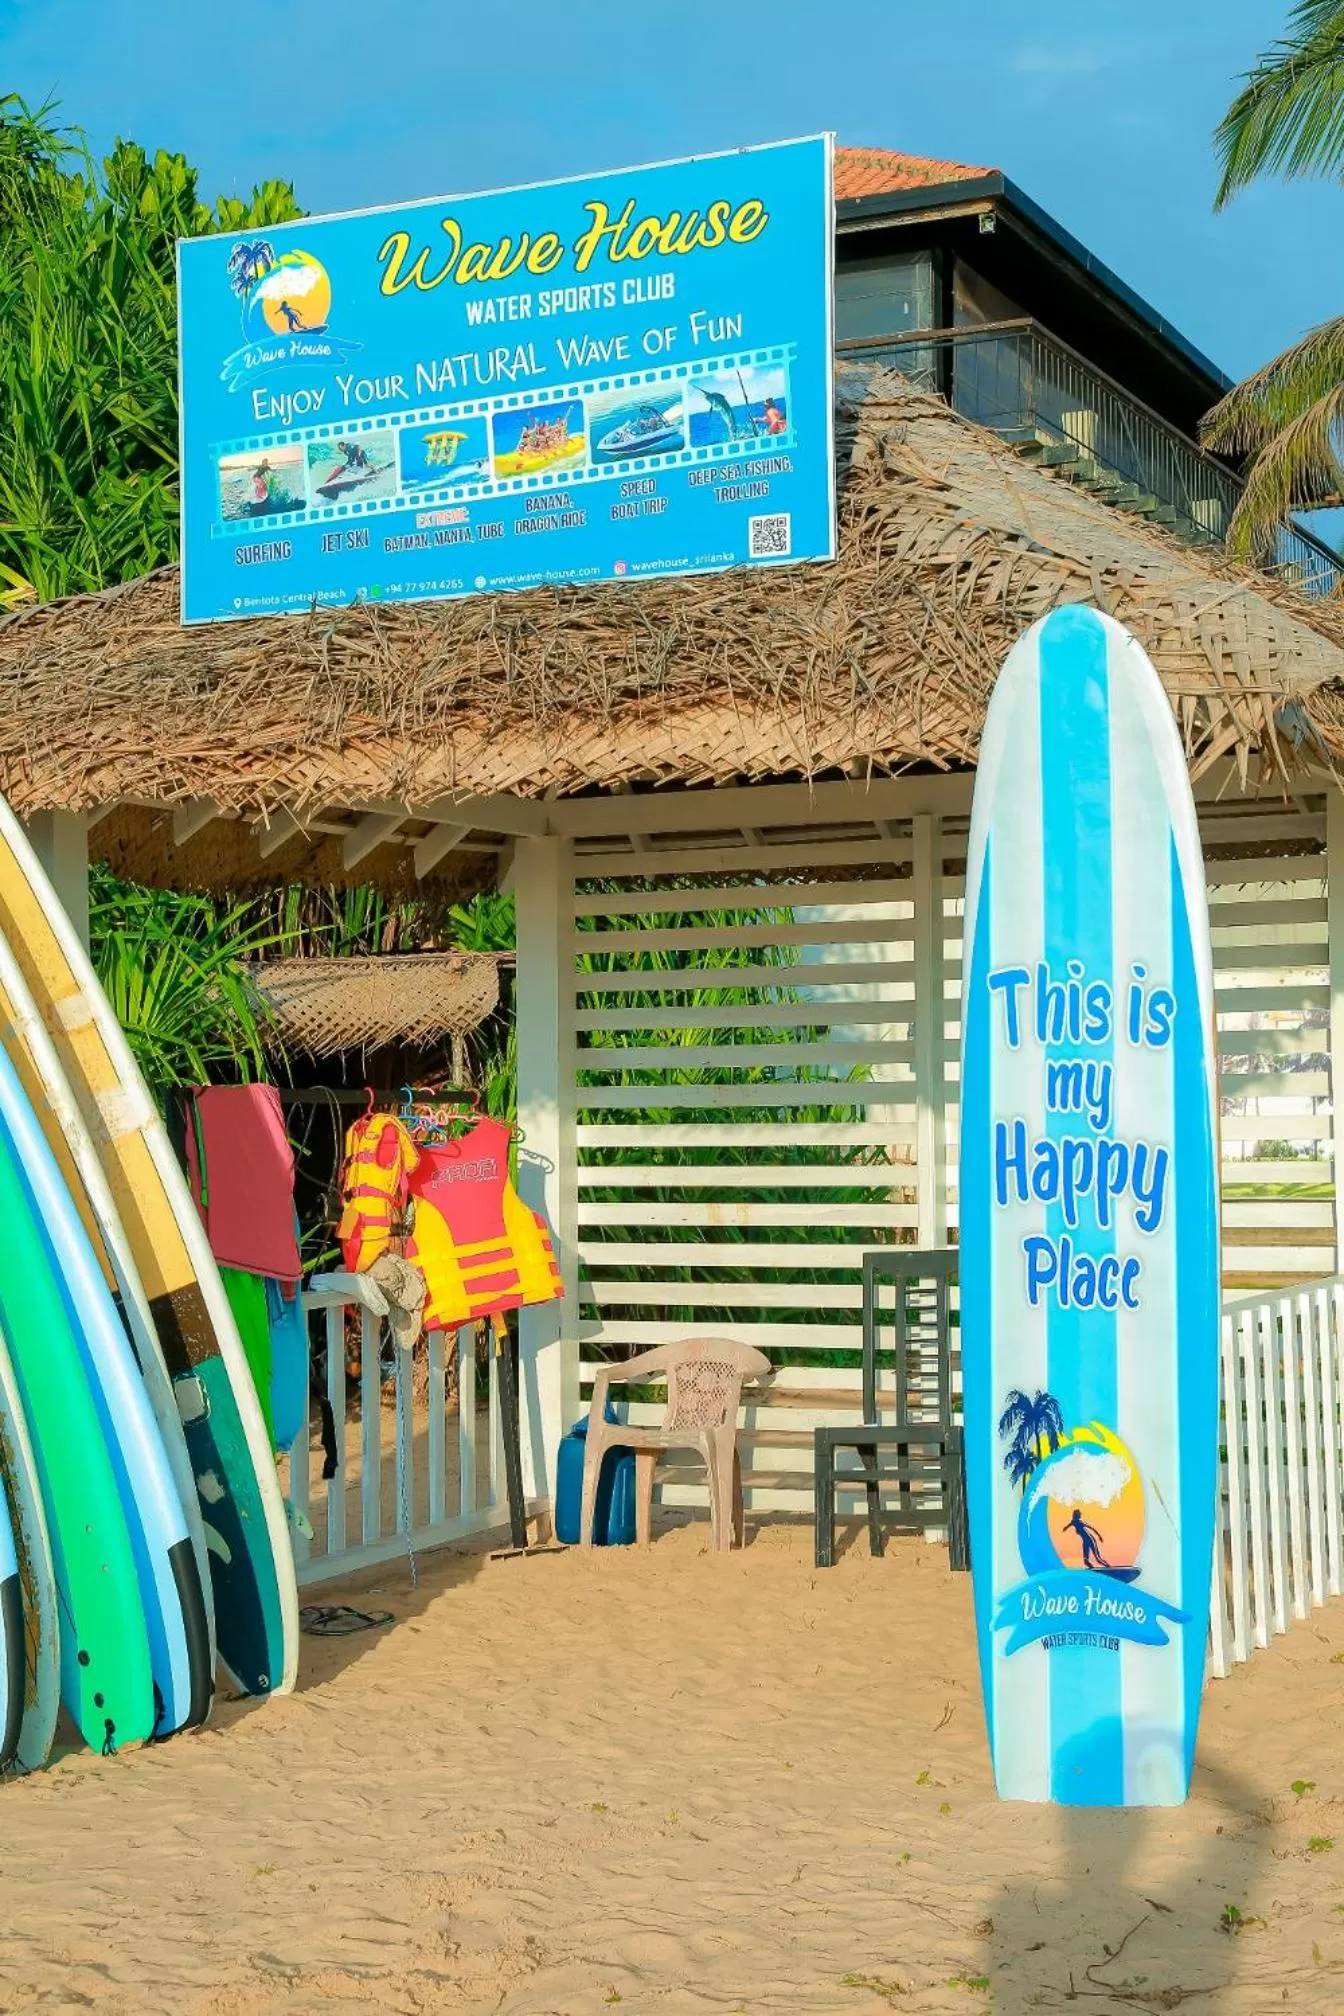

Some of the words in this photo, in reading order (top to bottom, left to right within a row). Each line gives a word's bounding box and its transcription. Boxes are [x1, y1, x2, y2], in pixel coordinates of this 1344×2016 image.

[378, 218, 564, 296] Wave
[573, 198, 770, 272] House
[466, 294, 531, 326] WATER
[539, 283, 615, 317] SPORTS
[623, 273, 675, 304] CLUB
[244, 347, 286, 368] Wave
[290, 341, 331, 359] House
[415, 342, 546, 394] NATURAL
[689, 468, 717, 486] DEEP
[720, 464, 744, 481] SEA
[745, 456, 793, 477] FISHING,
[621, 478, 656, 497] SPEED
[714, 481, 769, 502] TROLLING
[525, 492, 574, 513] BANANA,
[611, 502, 640, 520] BOAT
[643, 497, 668, 515] TRIP
[477, 522, 504, 540] TUBE
[515, 515, 559, 534] DRAGON
[561, 510, 586, 528] RIDE
[236, 541, 292, 565] SURFING
[322, 533, 343, 553] JET
[347, 528, 369, 549] SKI
[988, 960, 1113, 1048] This
[1128, 964, 1176, 1048] is
[1046, 1060, 1113, 1131] my
[994, 1120, 1170, 1232] Happy
[1023, 1236, 1140, 1309] Place
[1021, 1585, 1080, 1621] Wave
[1084, 1585, 1147, 1623] House
[1041, 1633, 1066, 1651] WATER
[1067, 1632, 1097, 1647] SPORTS
[1099, 1634, 1120, 1652] CLUB
